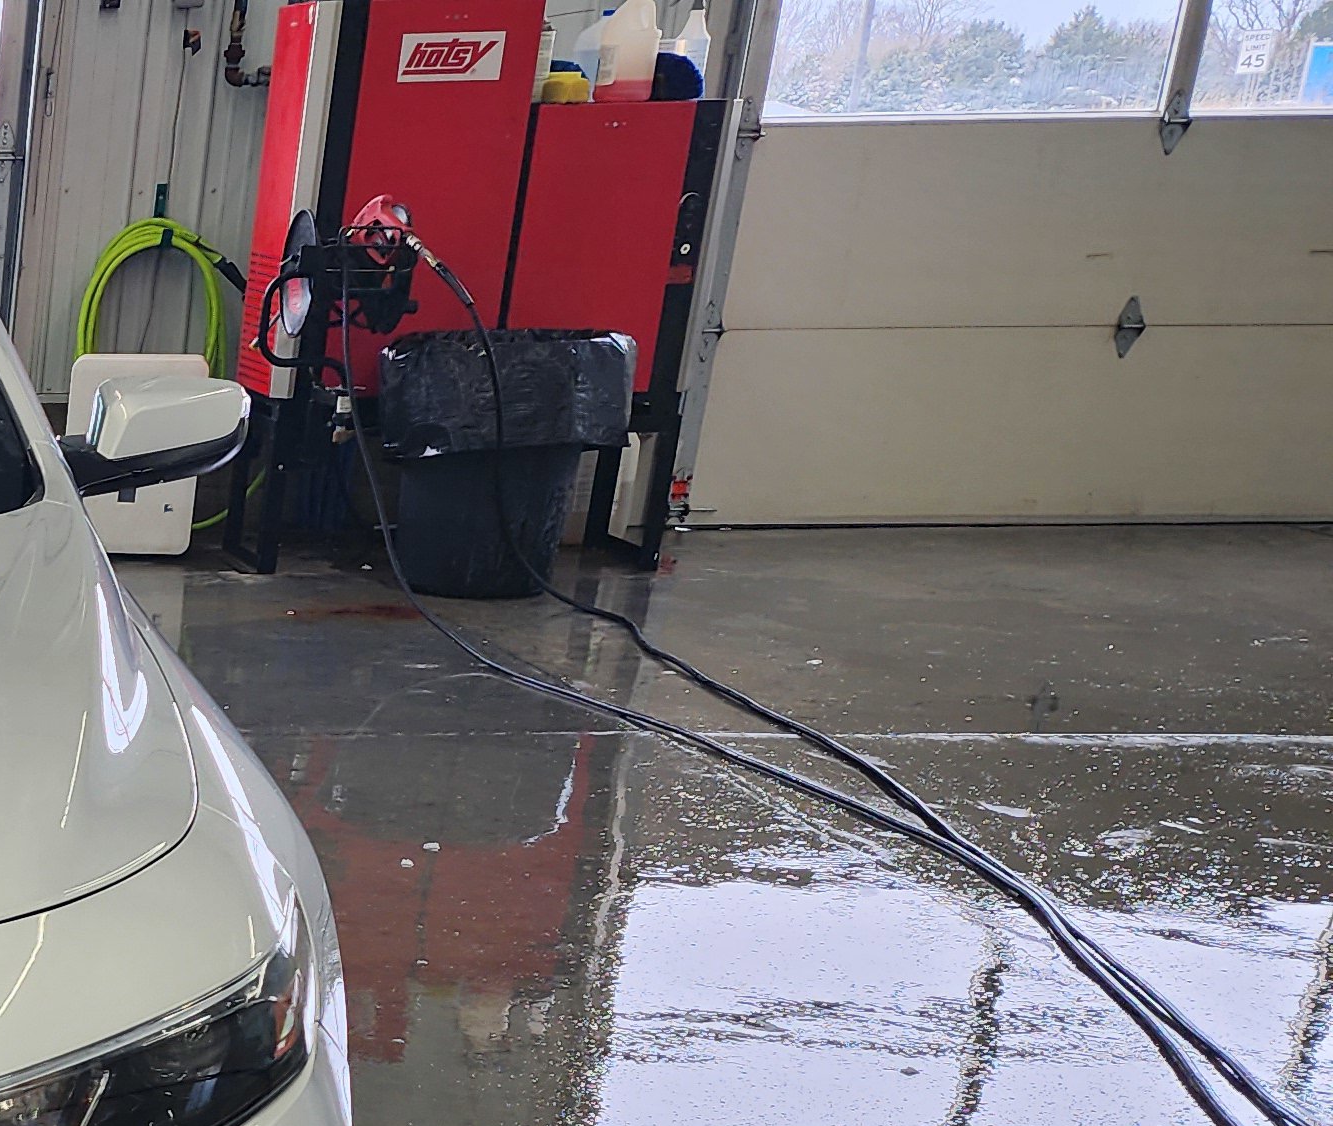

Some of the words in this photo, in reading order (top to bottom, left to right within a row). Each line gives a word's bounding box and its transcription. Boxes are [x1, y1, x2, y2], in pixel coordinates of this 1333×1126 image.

[1244, 33, 1271, 41] SPEED
[401, 38, 499, 75] hotsy
[1240, 53, 1265, 68] 45
